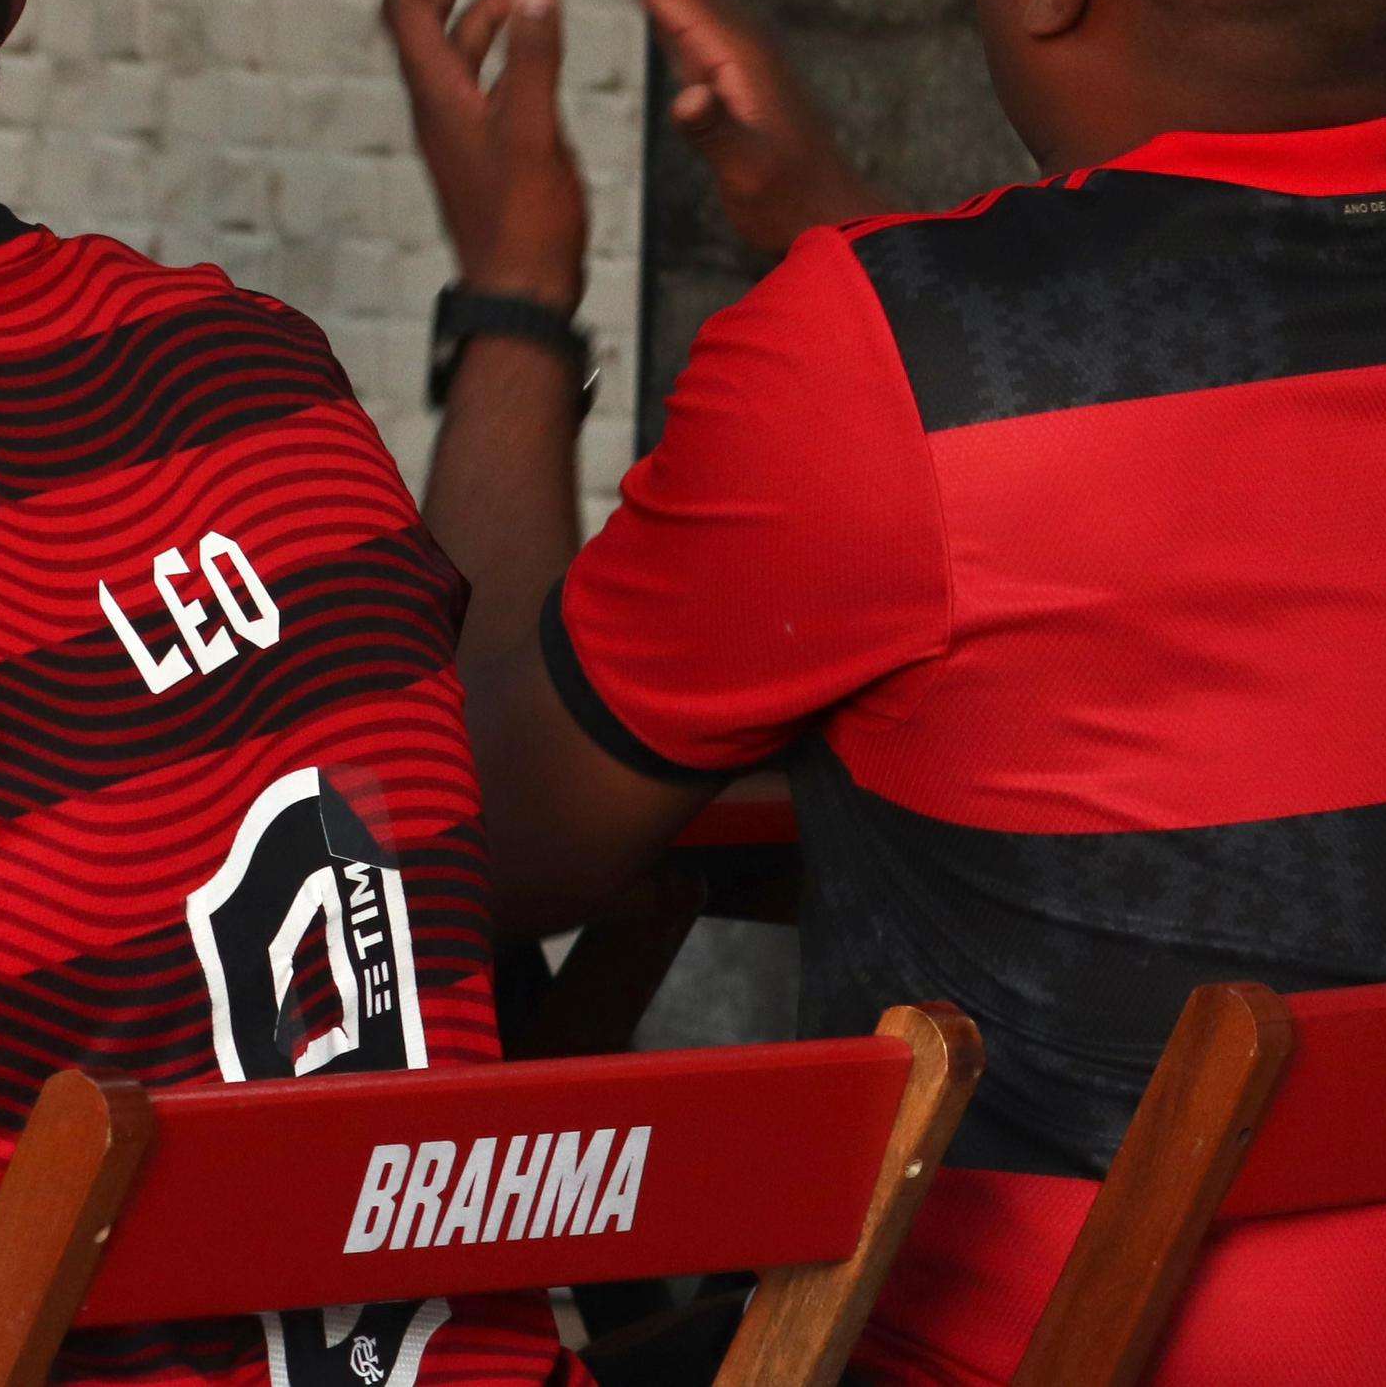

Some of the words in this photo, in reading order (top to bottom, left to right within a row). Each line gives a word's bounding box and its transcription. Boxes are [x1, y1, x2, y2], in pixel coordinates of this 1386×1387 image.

[1344, 203, 1368, 214] ANO
[1370, 201, 1386, 212] DE
[98, 530, 280, 695] LEO
[342, 1125, 653, 1254] BRAHMA
